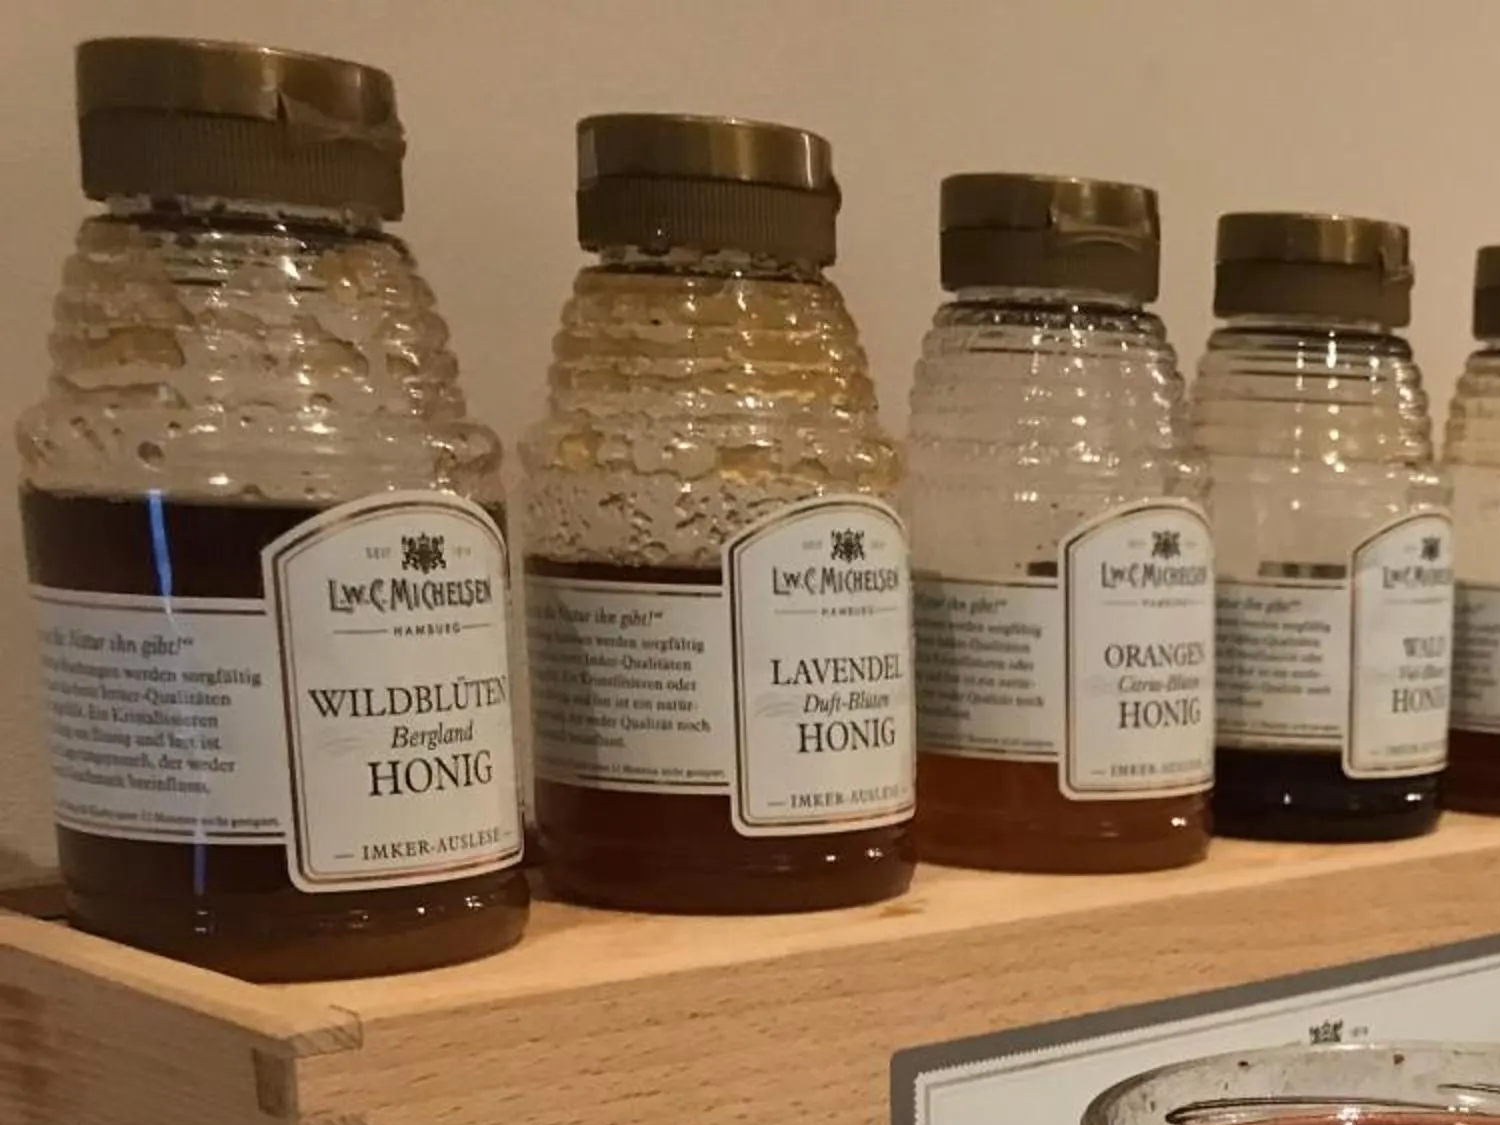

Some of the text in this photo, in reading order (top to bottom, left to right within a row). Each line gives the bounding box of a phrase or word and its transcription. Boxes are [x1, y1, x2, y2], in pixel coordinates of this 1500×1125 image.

[393, 622, 462, 637] HAMBURG
[770, 652, 903, 685] LAVENDEL
[1118, 696, 1201, 729] HONIG
[391, 719, 474, 750] Bergland
[797, 716, 896, 753] HONIG
[367, 750, 493, 797] HONIG
